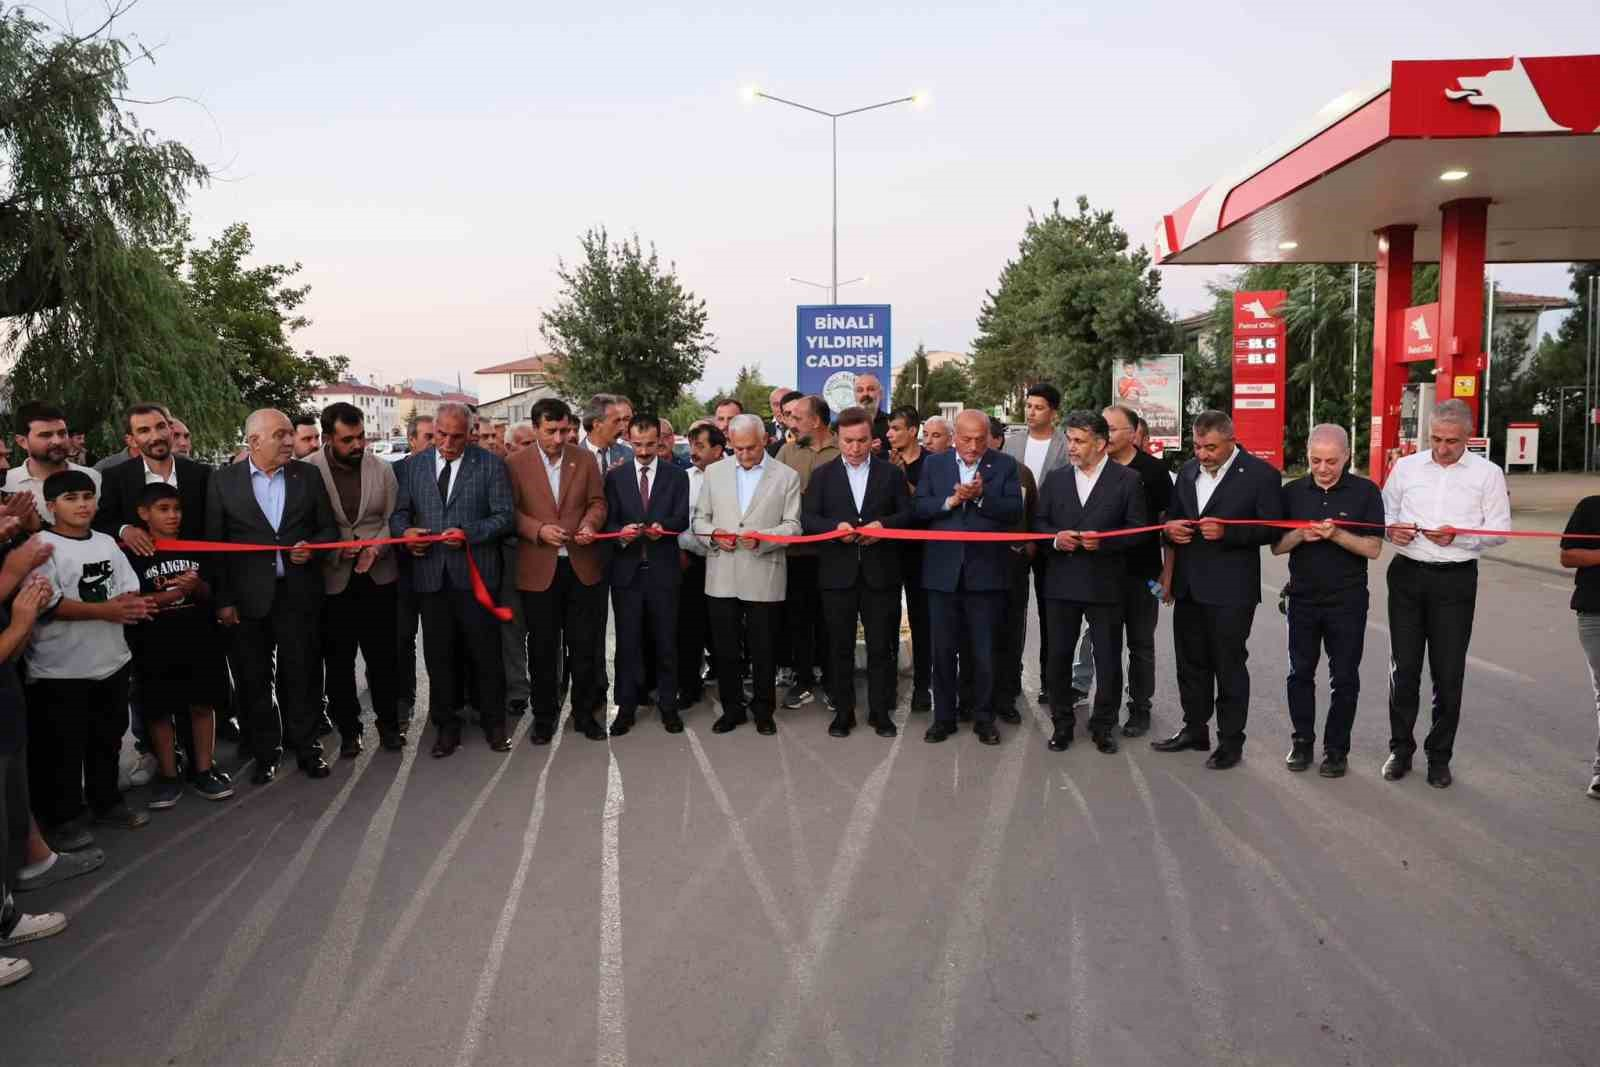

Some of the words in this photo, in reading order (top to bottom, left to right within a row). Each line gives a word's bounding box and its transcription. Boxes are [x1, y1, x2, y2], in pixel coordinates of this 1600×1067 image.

[815, 314, 874, 330] BİNALİ
[806, 335, 883, 349] YILDIRIM
[806, 352, 884, 368] CADDESİ
[83, 560, 114, 578] NIKE
